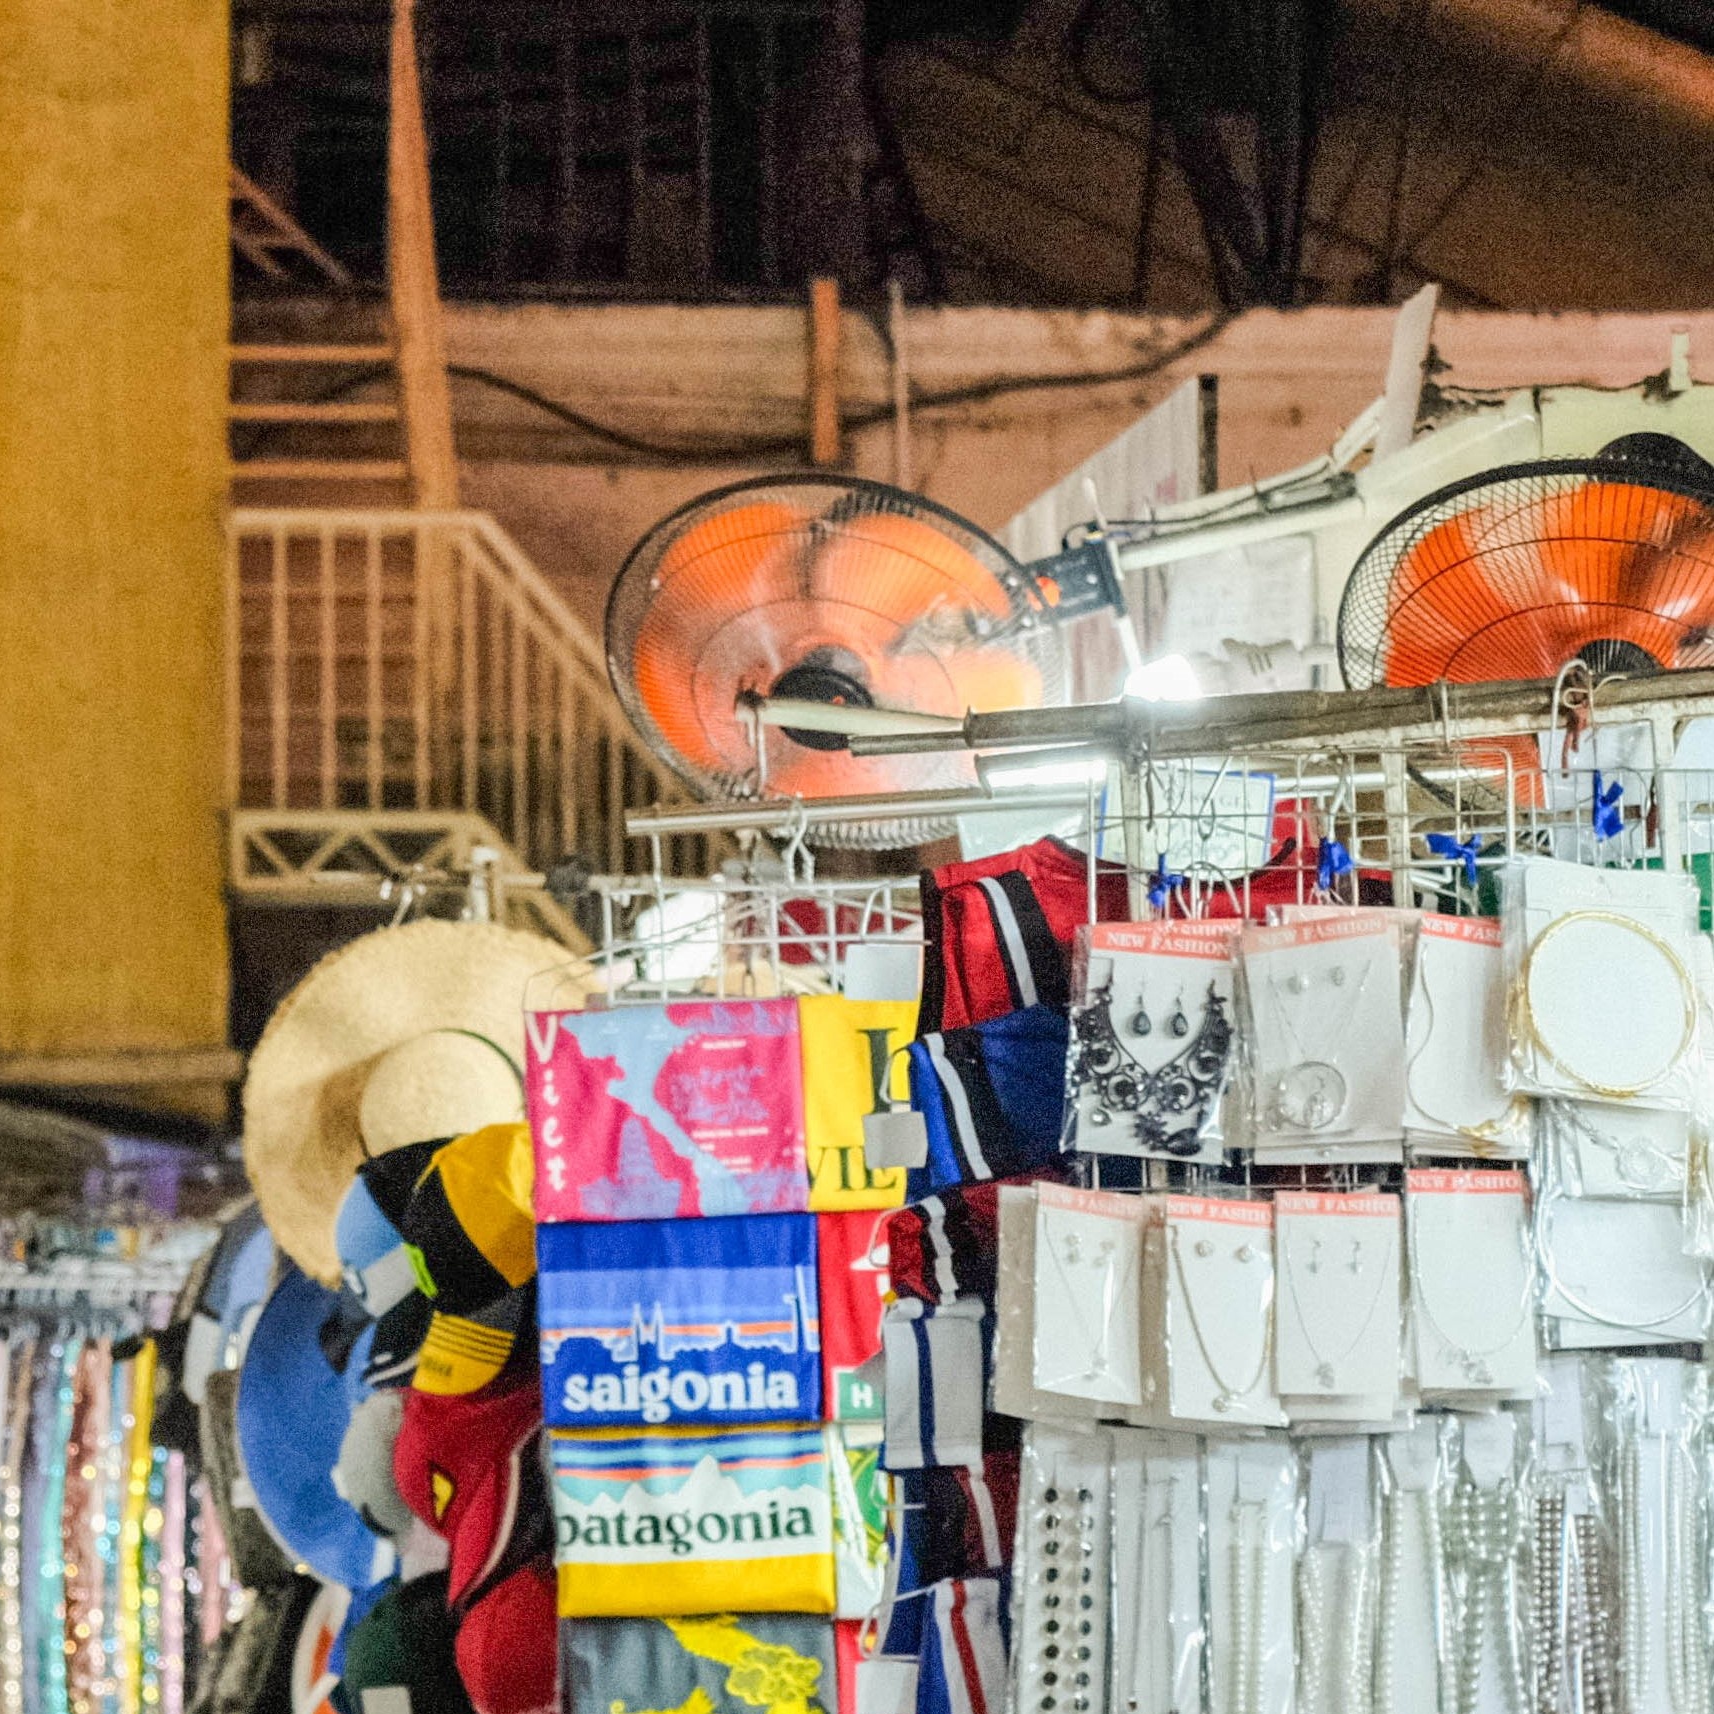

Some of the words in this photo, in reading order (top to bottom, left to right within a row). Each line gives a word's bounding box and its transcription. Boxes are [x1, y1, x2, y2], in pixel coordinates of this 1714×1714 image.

[1256, 928, 1296, 947] NEW
[1302, 916, 1383, 941] FASHION
[1422, 918, 1459, 935] NEW
[1107, 932, 1145, 947] NEW
[1151, 936, 1229, 956] FASHION
[1408, 1173, 1447, 1188] NEW
[1168, 1200, 1204, 1216] NEW
[1279, 1196, 1319, 1211] NEW
[562, 1365, 799, 1424] saigonia
[558, 1500, 815, 1556] patagonia
